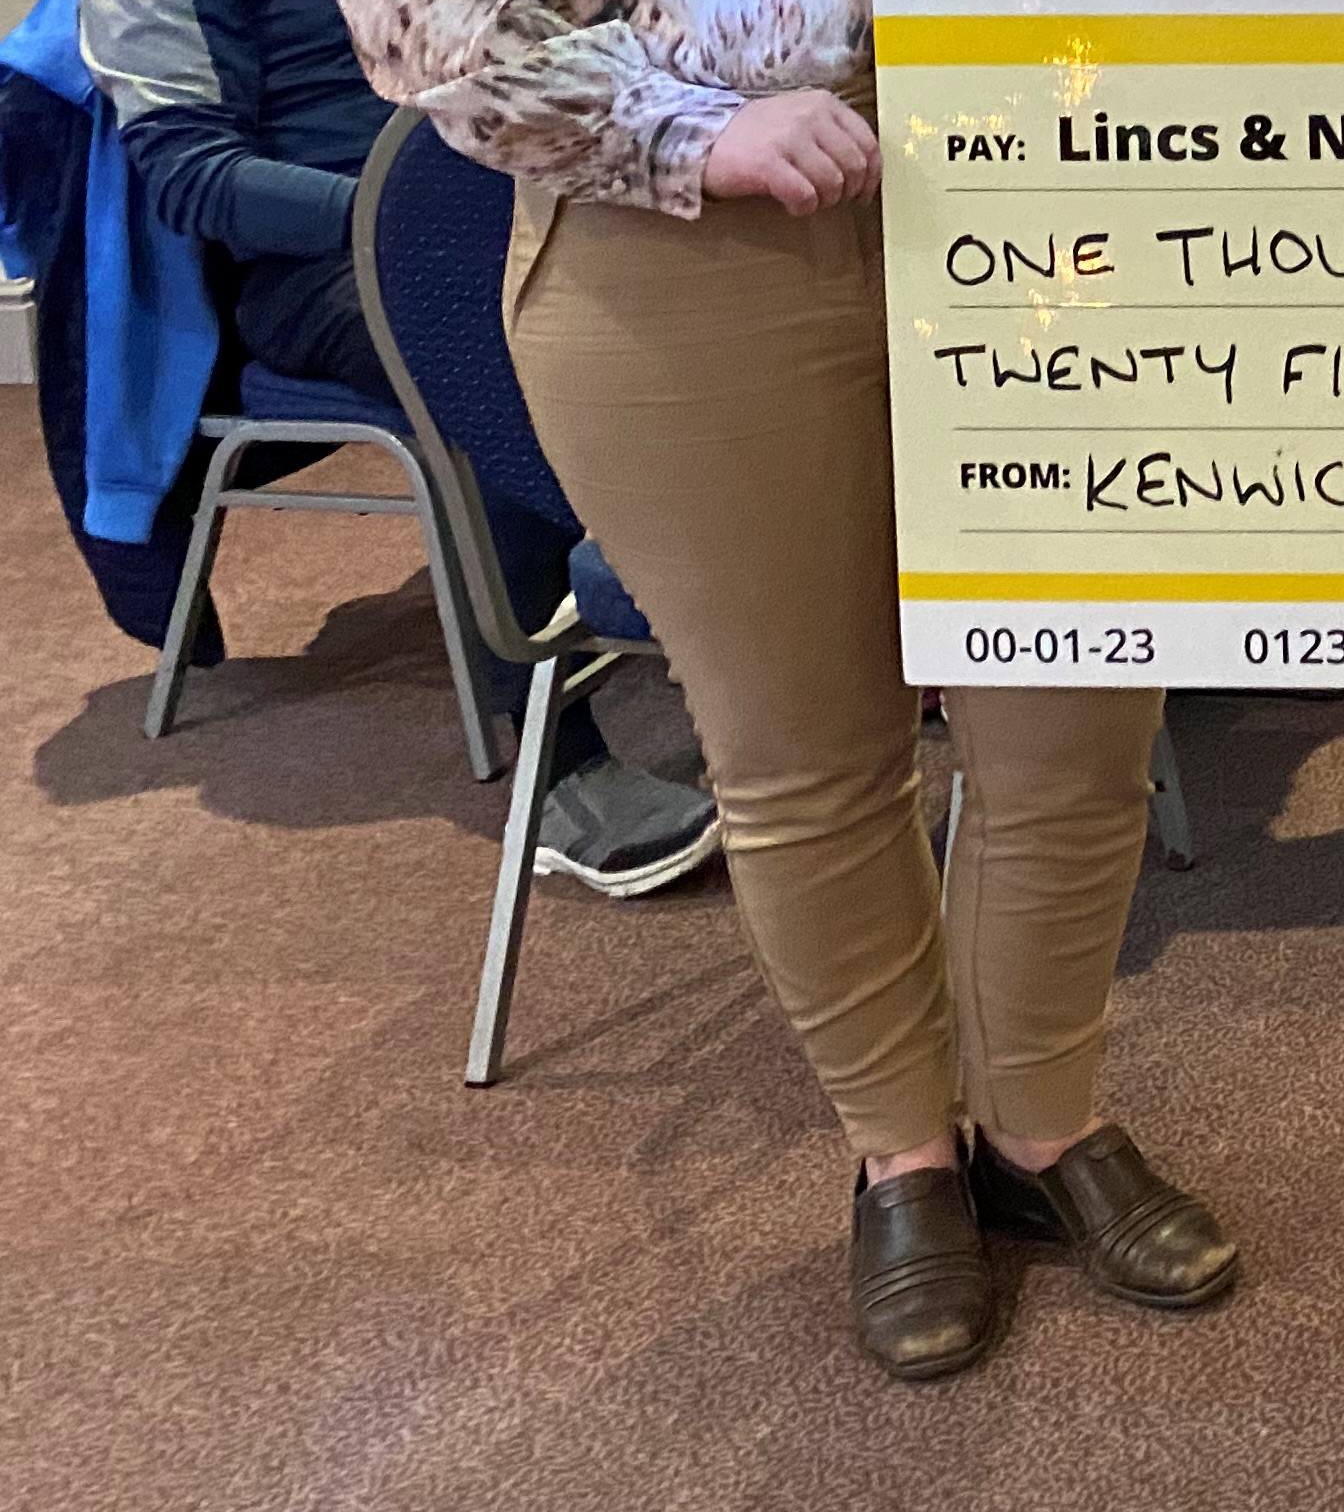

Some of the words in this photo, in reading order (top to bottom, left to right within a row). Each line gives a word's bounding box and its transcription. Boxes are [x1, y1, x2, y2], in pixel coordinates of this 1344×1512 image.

[947, 134, 1026, 162] PAY:
[1058, 111, 1220, 162] Lincs
[1239, 114, 1289, 162] &
[946, 232, 1115, 287] ONE
[933, 343, 1237, 405] TWENTY
[960, 462, 1071, 490] FROM:
[965, 627, 1155, 664] 00-01-23
